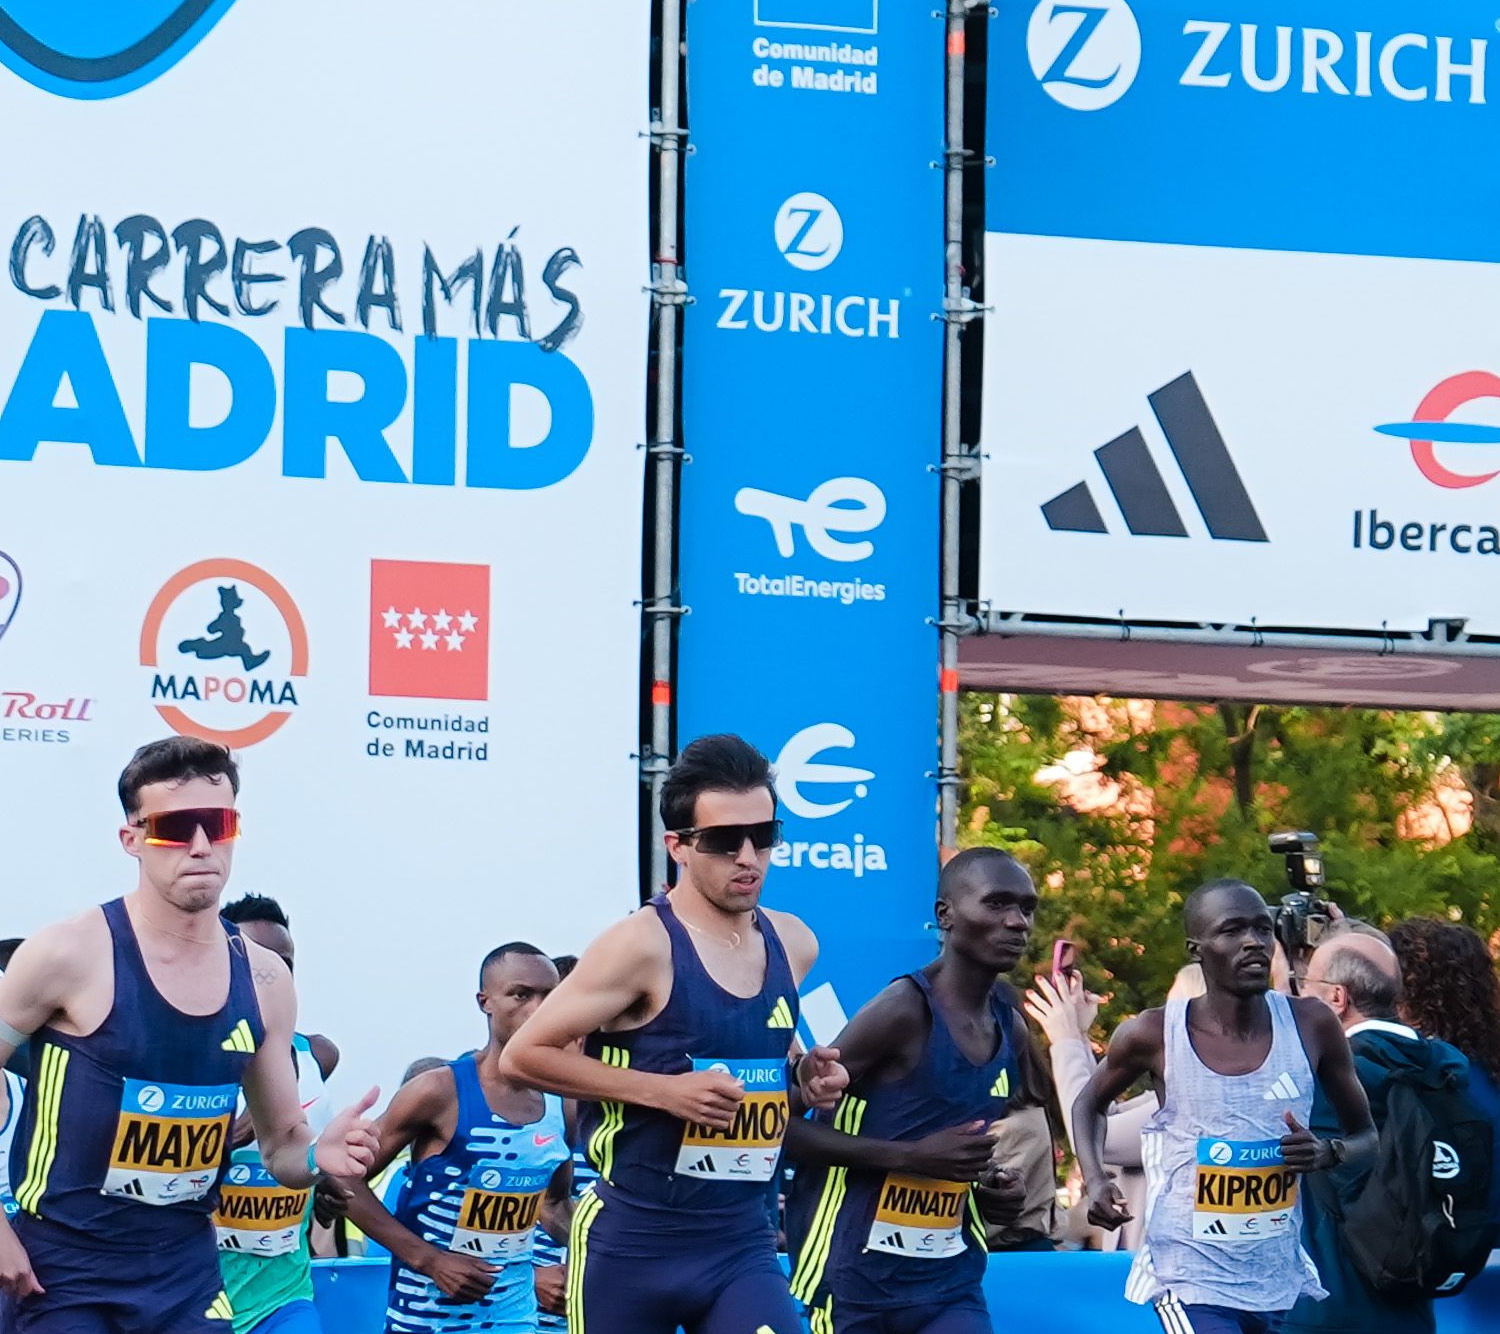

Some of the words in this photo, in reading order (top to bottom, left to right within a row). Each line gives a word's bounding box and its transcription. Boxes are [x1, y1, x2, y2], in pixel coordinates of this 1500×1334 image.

[752, 36, 879, 67] Comunidad
[1179, 20, 1489, 105] ZURICH
[752, 64, 784, 88] de
[790, 65, 878, 95] Madrid
[7, 208, 405, 333] CARRERA
[420, 225, 584, 353] MÁS
[715, 288, 900, 339] ZURICH
[733, 571, 886, 605] TotalEnergies
[151, 672, 299, 709] MAPOMA
[366, 710, 491, 734] Comunidad
[365, 738, 396, 759] de
[403, 738, 490, 762] Madrid
[771, 834, 888, 878] ercaja
[171, 1094, 229, 1110] ZURICH
[117, 1120, 223, 1168] MAYO
[1238, 1145, 1282, 1163] ZURIC
[882, 1183, 962, 1219] MINATU
[1198, 1170, 1295, 1206] KIPROP
[218, 1193, 308, 1220] WAWERU
[467, 1192, 540, 1231] KIRUI
